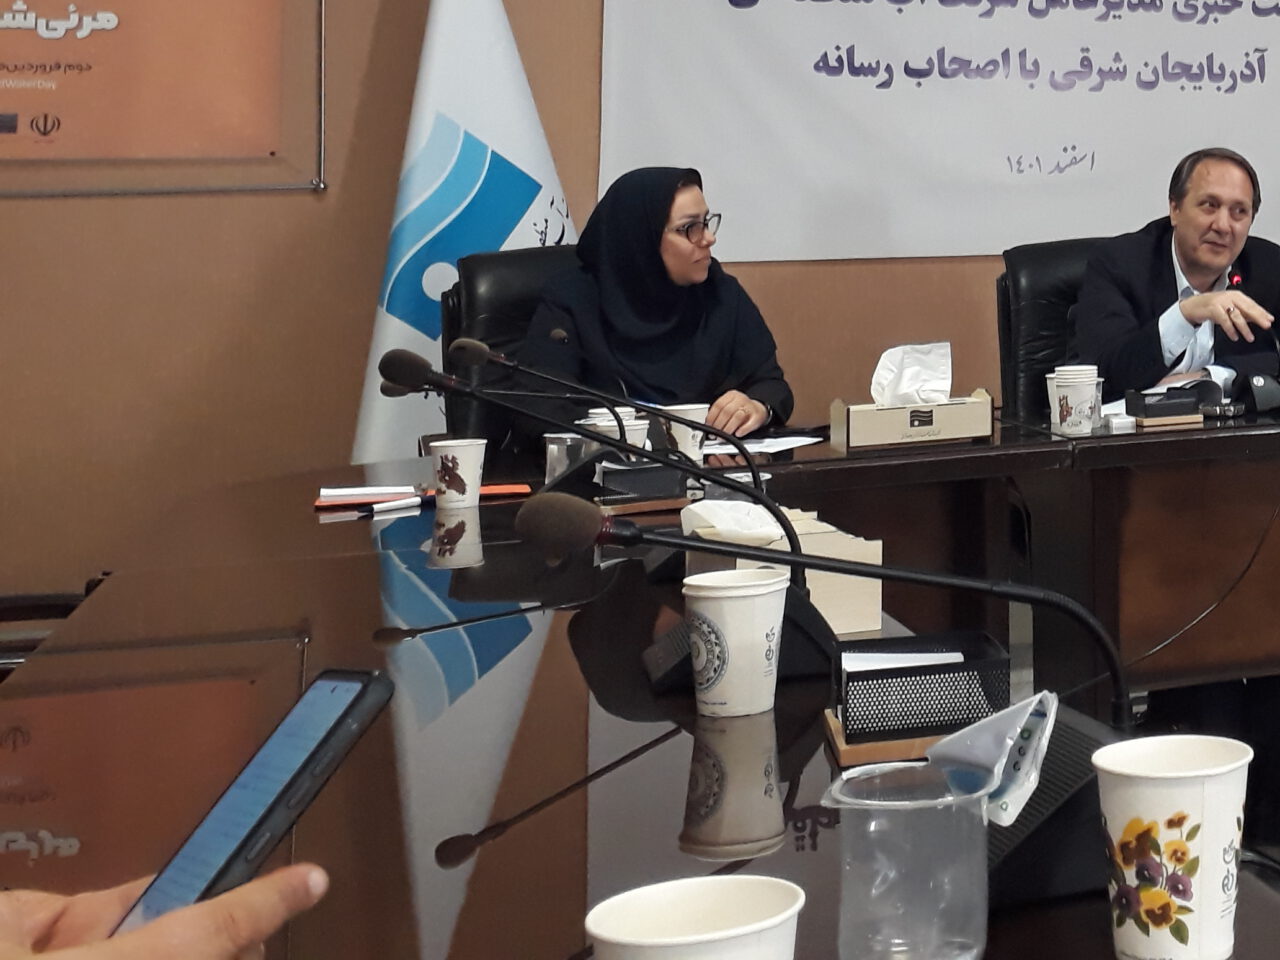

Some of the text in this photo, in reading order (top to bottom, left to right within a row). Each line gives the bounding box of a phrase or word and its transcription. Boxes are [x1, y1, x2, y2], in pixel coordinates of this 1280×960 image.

[813, 43, 1269, 94] آذربایجان شرقی با اصحاب رسانه
[1047, 144, 1095, 175] اسفند
